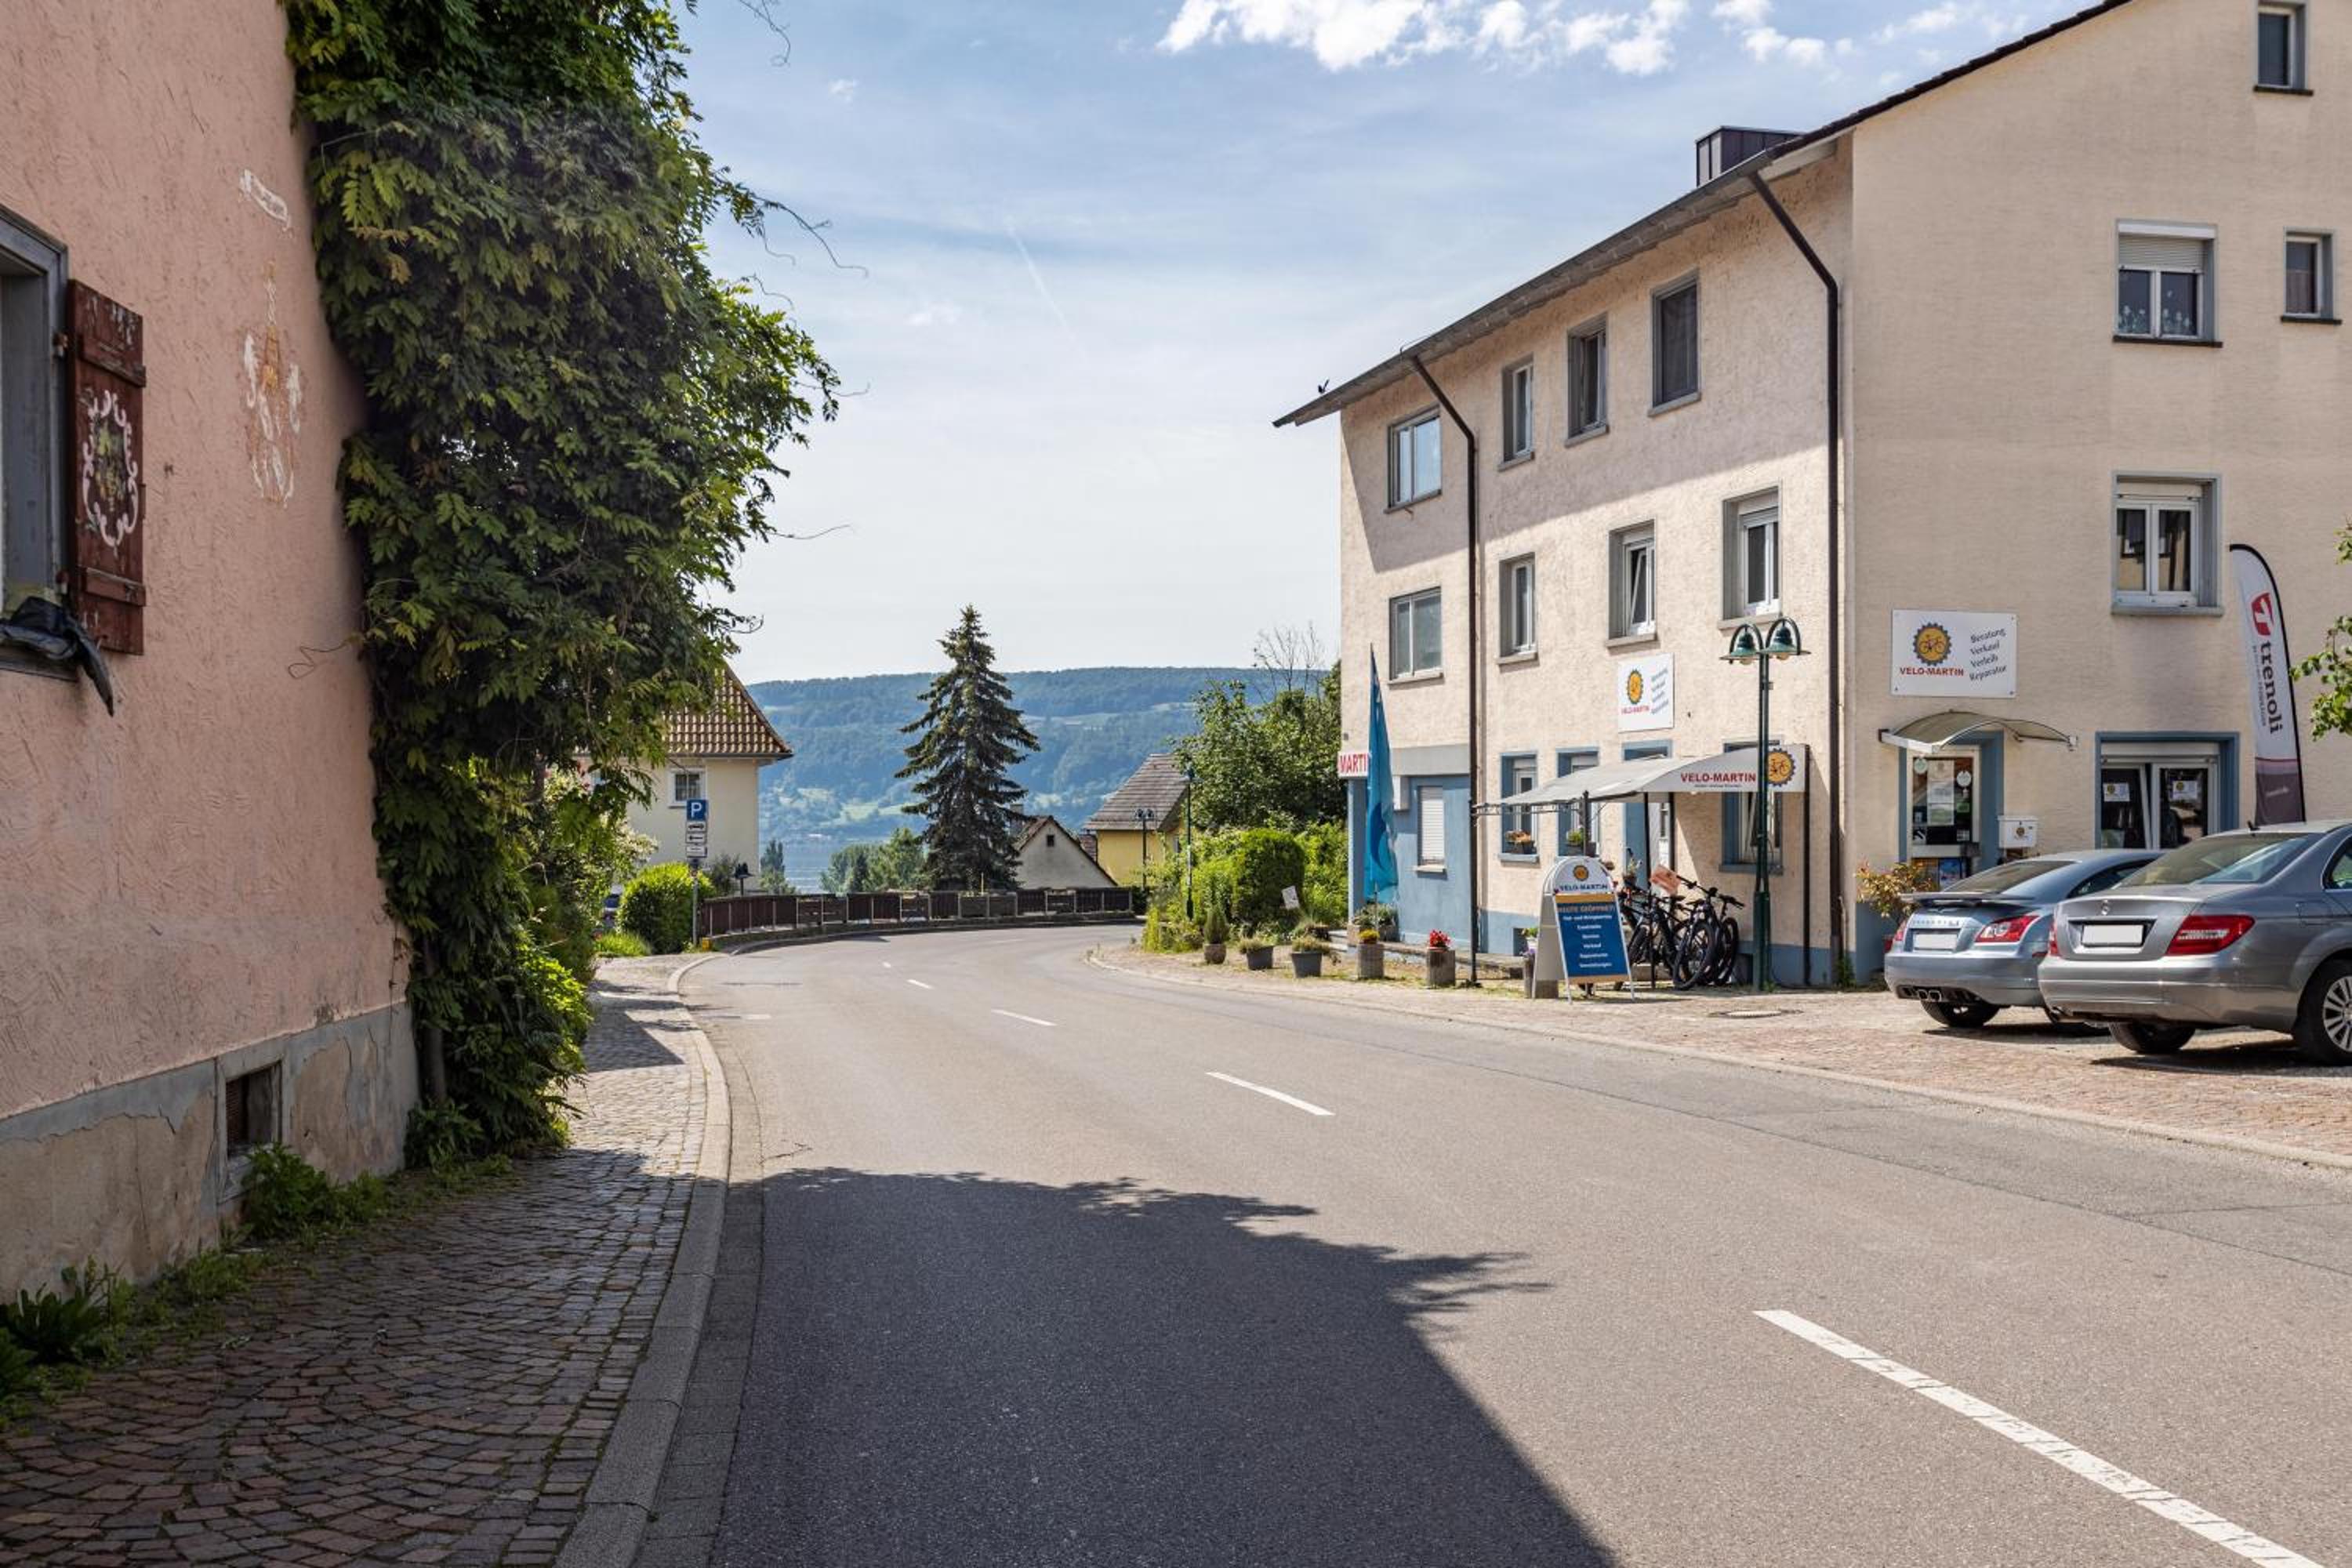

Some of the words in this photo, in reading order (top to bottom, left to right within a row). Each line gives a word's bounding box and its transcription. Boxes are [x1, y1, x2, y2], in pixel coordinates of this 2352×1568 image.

[1900, 666, 1964, 677] VELO-MARTIN
[2260, 641, 2283, 734] trenoli
[1680, 772, 1756, 782] VELO-MARTIN
[691, 802, 702, 818] P
